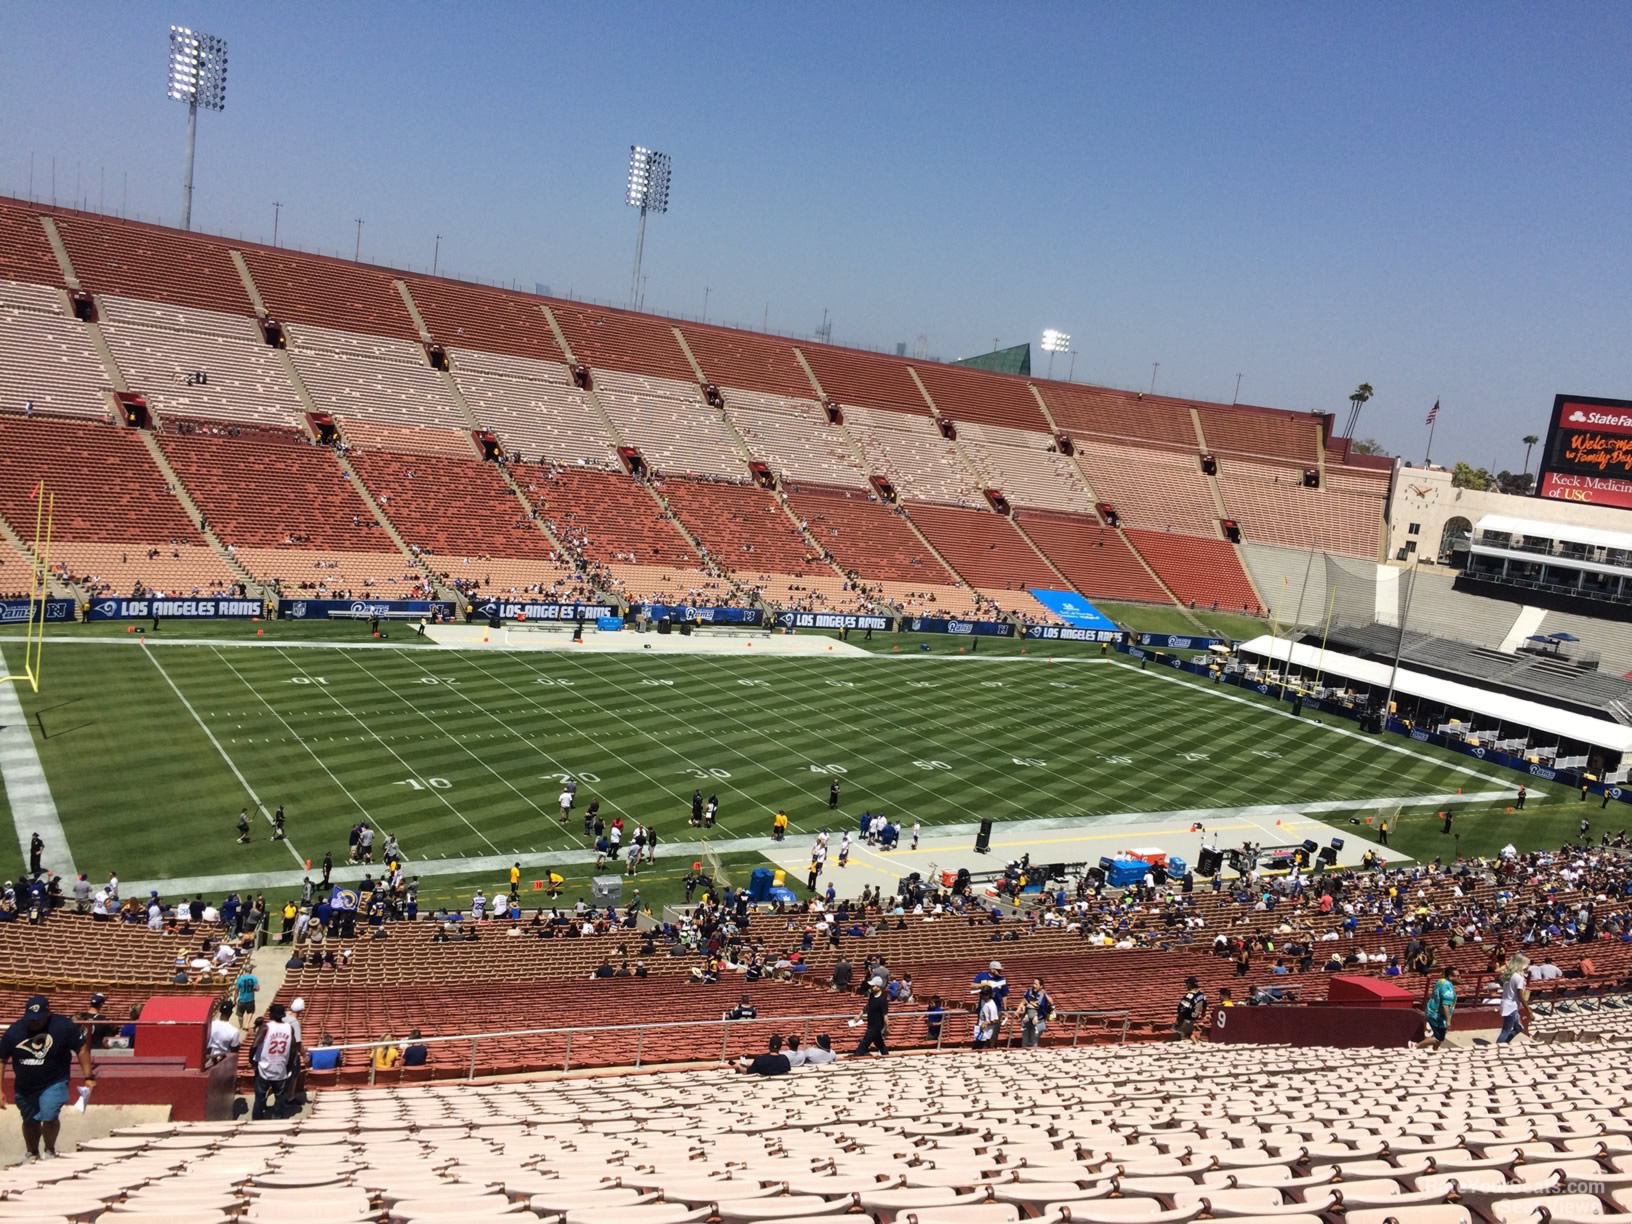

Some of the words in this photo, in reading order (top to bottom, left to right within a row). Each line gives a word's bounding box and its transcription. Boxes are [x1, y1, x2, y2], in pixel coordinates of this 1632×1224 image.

[1575, 450, 1610, 470] Family
[1551, 473, 1581, 487] Keck
[1548, 487, 1563, 498] of
[1564, 488, 1593, 502] USC
[121, 602, 148, 616] LOS
[152, 601, 215, 616] ANGELES
[219, 601, 261, 616] RAMS
[500, 605, 521, 618] LOS
[796, 613, 813, 627] LOS
[815, 615, 856, 630] ANGELES
[857, 617, 887, 630] RAMS
[1043, 627, 1059, 638] LOS
[1060, 628, 1096, 641] ANGELES
[810, 764, 848, 774] 40
[912, 760, 952, 770] 50
[1012, 758, 1047, 766] 40
[551, 772, 601, 784] 20
[686, 768, 732, 779] 30
[1530, 764, 1556, 780] Rams
[405, 777, 453, 790] 10
[1217, 1011, 1226, 1029] 9
[268, 1041, 288, 1055] 23
